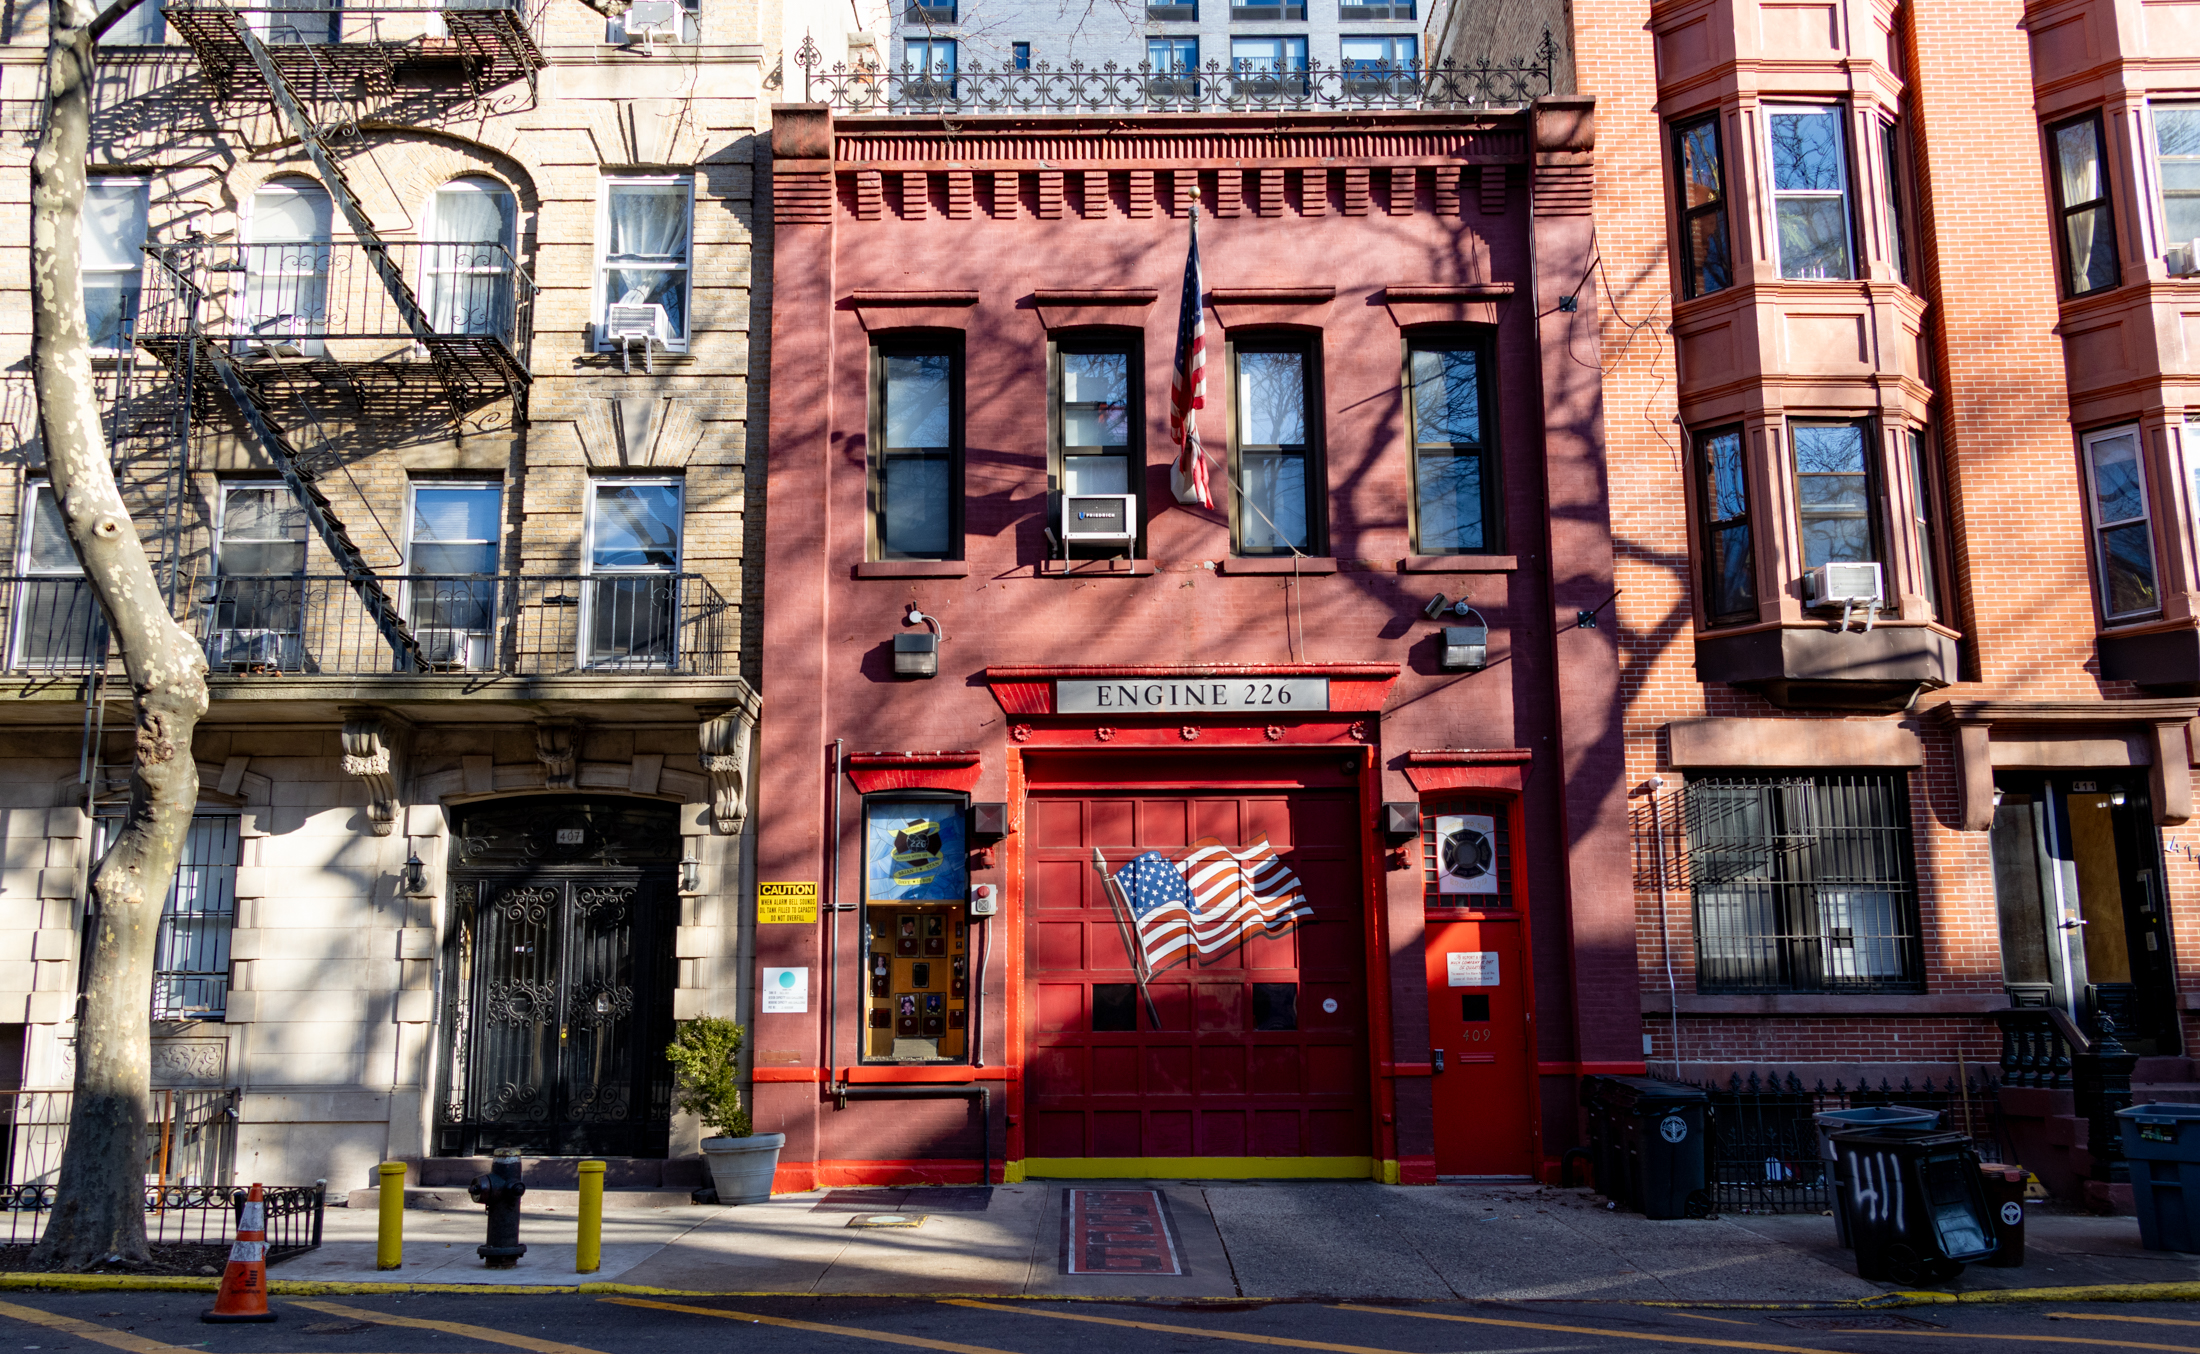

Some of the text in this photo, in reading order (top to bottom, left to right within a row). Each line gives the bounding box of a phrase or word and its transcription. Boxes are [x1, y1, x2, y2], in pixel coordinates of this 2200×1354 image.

[1096, 684, 1292, 707] ENGINE 226
[2074, 782, 2095, 791] 411
[560, 831, 581, 841] 407
[898, 868, 914, 876] BRIAN
[762, 885, 814, 895] CAUTION
[1463, 1028, 1491, 1042] 409
[1848, 1150, 1905, 1232] 411
